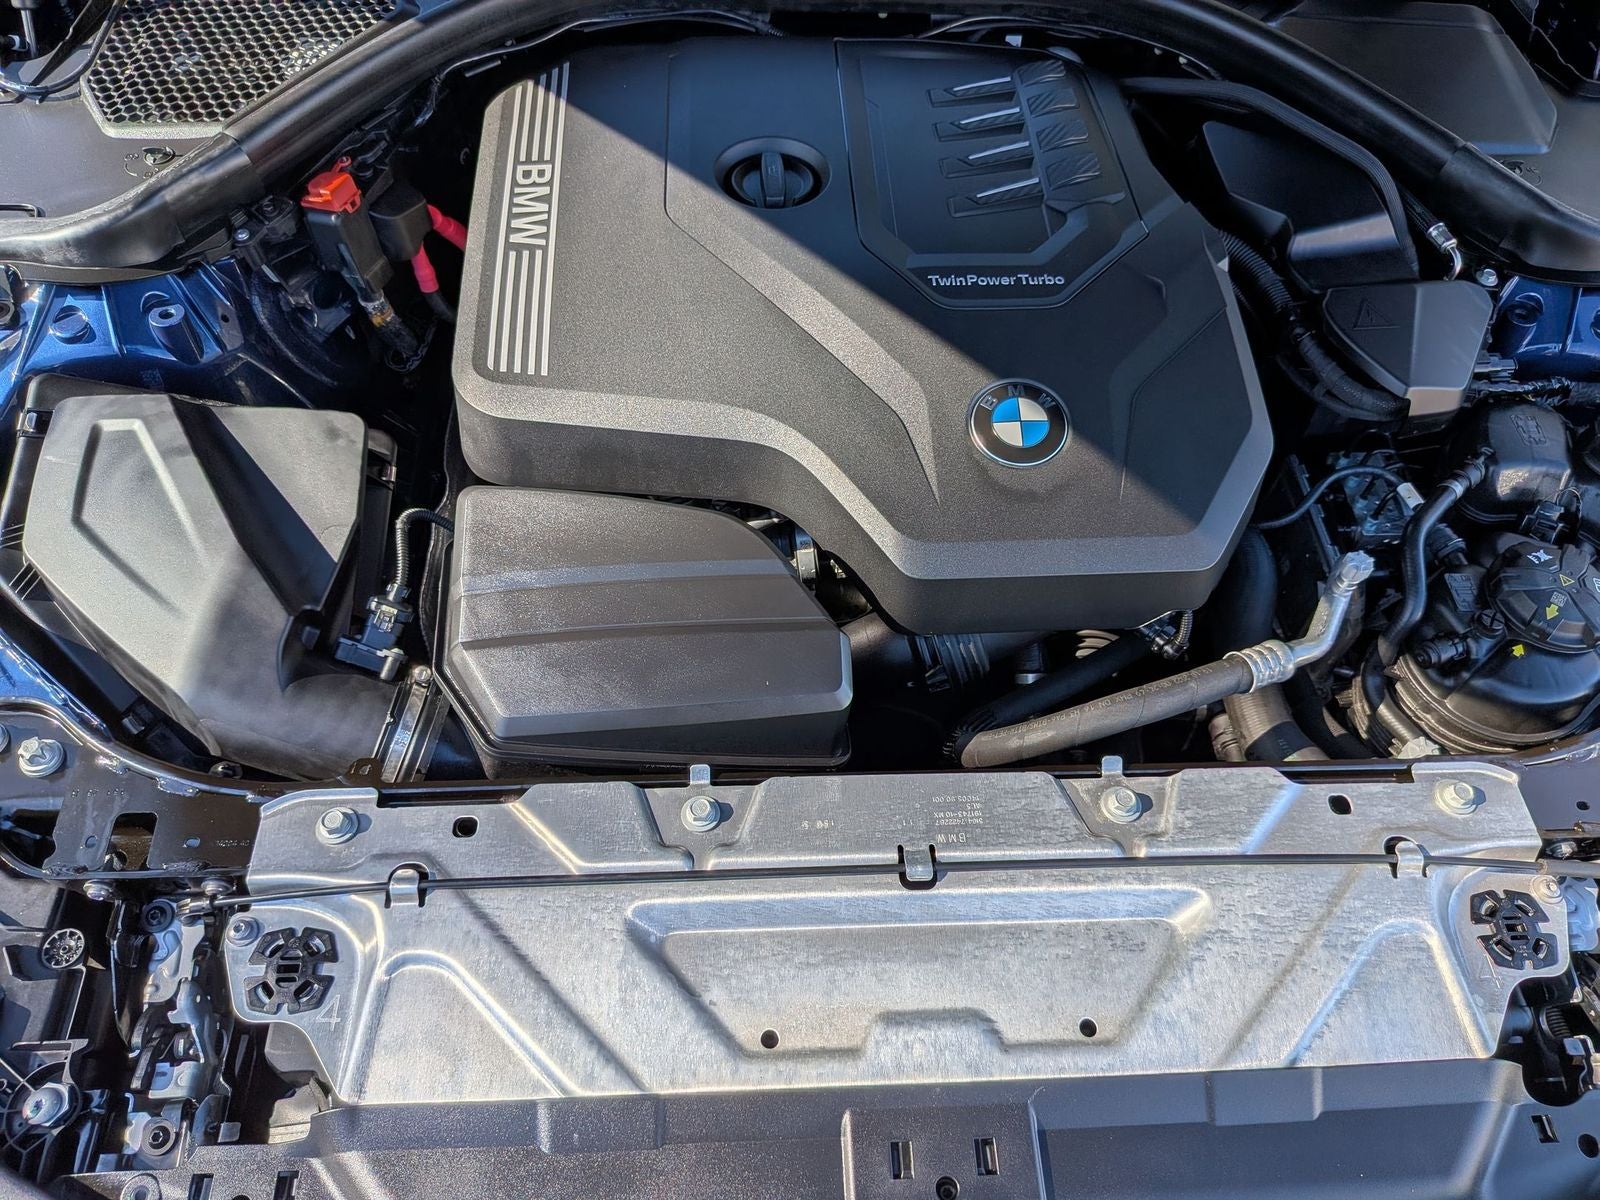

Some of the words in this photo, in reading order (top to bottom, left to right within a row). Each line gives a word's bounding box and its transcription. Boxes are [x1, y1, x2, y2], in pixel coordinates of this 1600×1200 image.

[509, 164, 552, 246] BMW
[1017, 273, 1065, 285] Turbo
[980, 384, 1056, 411] BMW
[1098, 700, 1111, 710] DN
[936, 832, 966, 843] BMW
[315, 994, 341, 1031] 4
